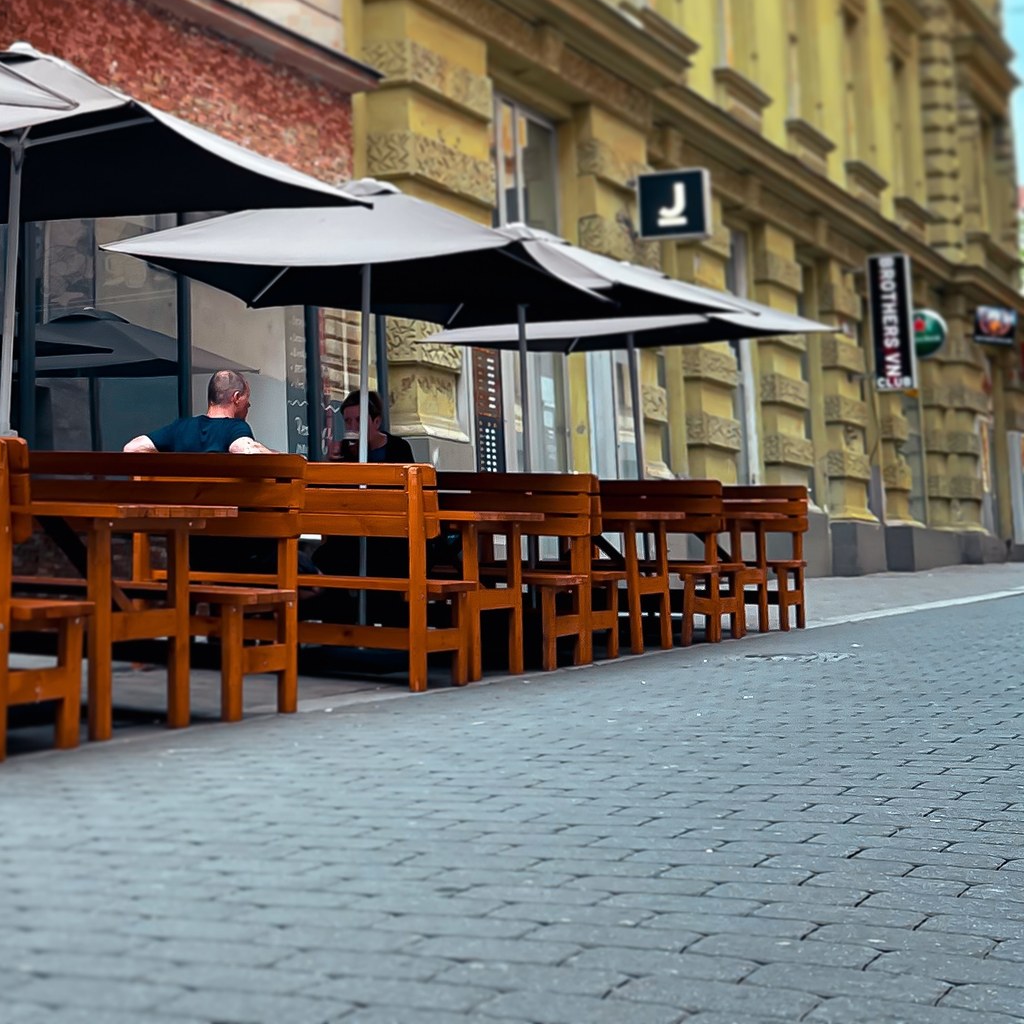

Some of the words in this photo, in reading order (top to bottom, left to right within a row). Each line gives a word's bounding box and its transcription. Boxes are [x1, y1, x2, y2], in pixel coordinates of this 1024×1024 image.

[658, 182, 686, 218] J
[878, 257, 901, 349] BROTHERS
[877, 376, 912, 389] CLUB
